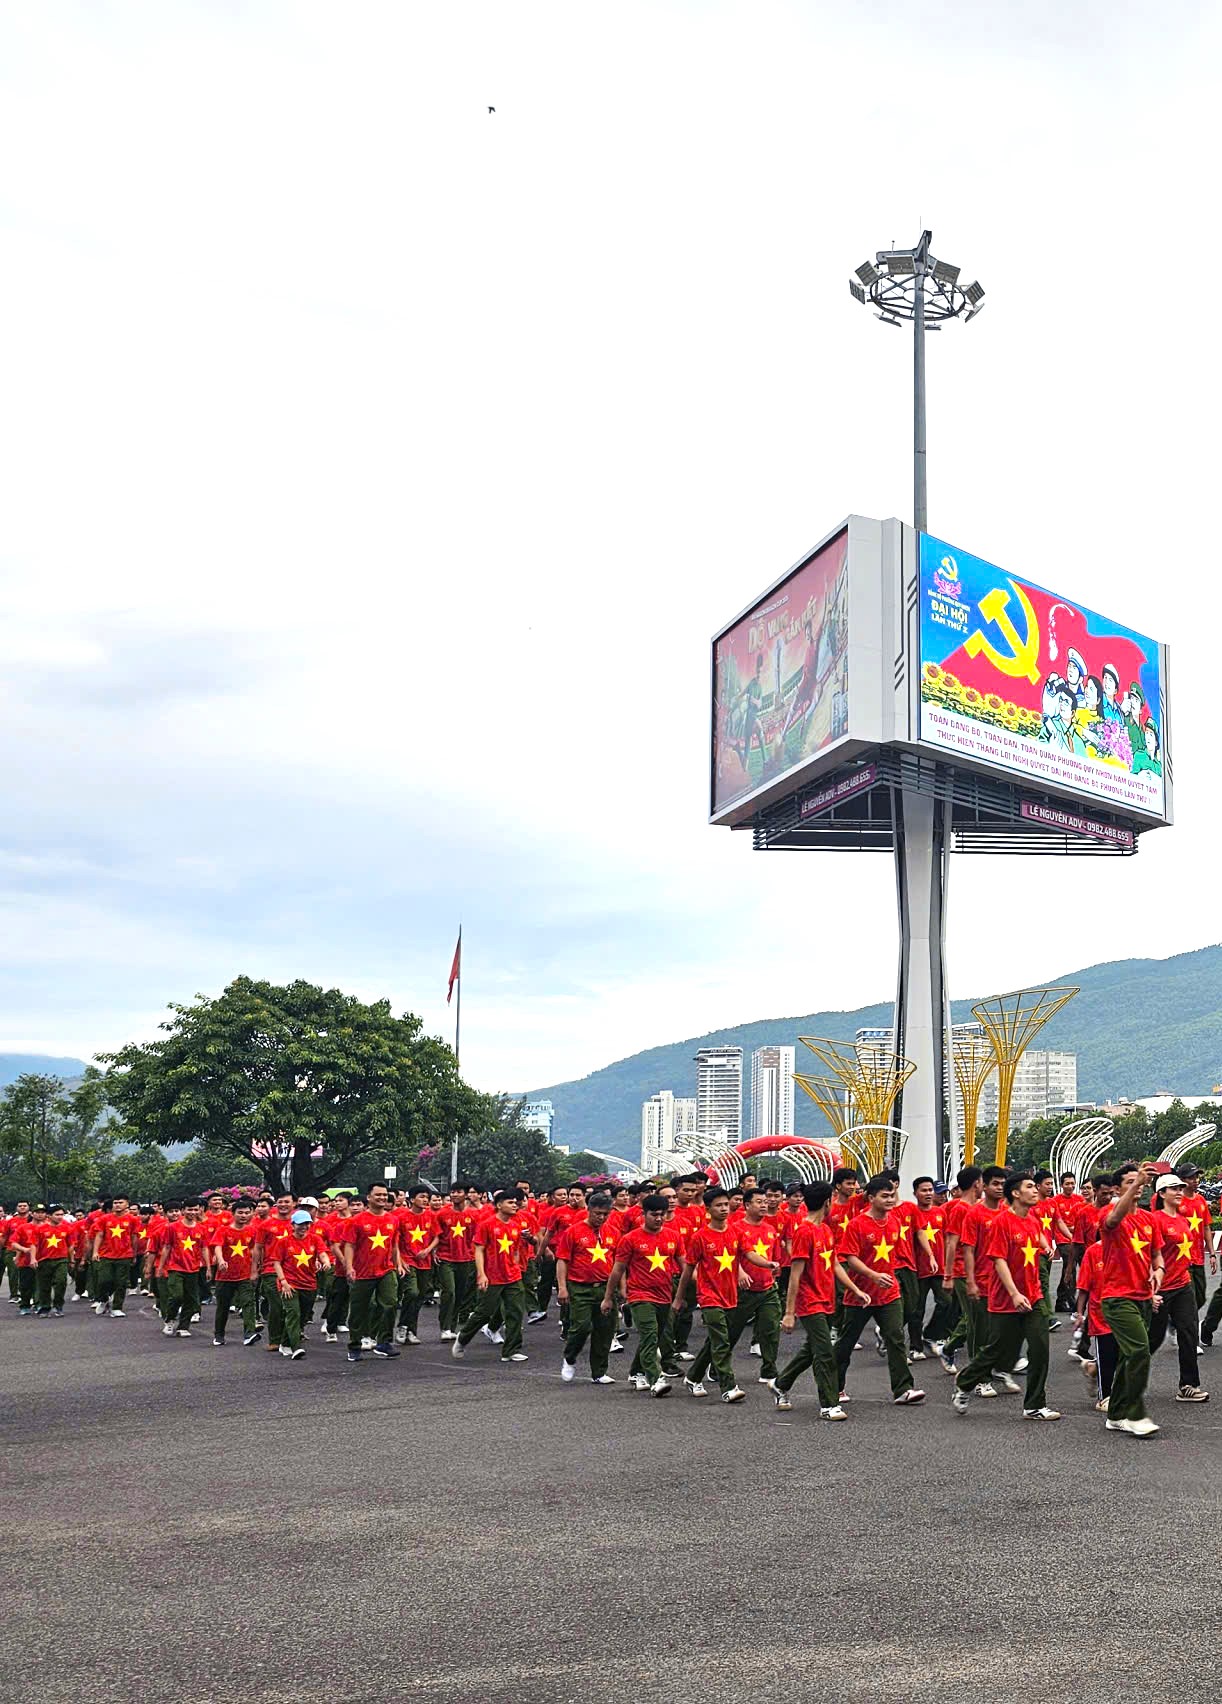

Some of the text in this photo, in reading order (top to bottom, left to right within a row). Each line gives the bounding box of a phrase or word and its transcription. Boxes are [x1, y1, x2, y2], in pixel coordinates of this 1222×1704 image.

[824, 788, 836, 802] ADV
[1030, 804, 1038, 816] LÊ
[1040, 808, 1068, 824] NGUYỄN
[1068, 816, 1082, 828] ADV
[1087, 822, 1129, 841] 0982.488.655
